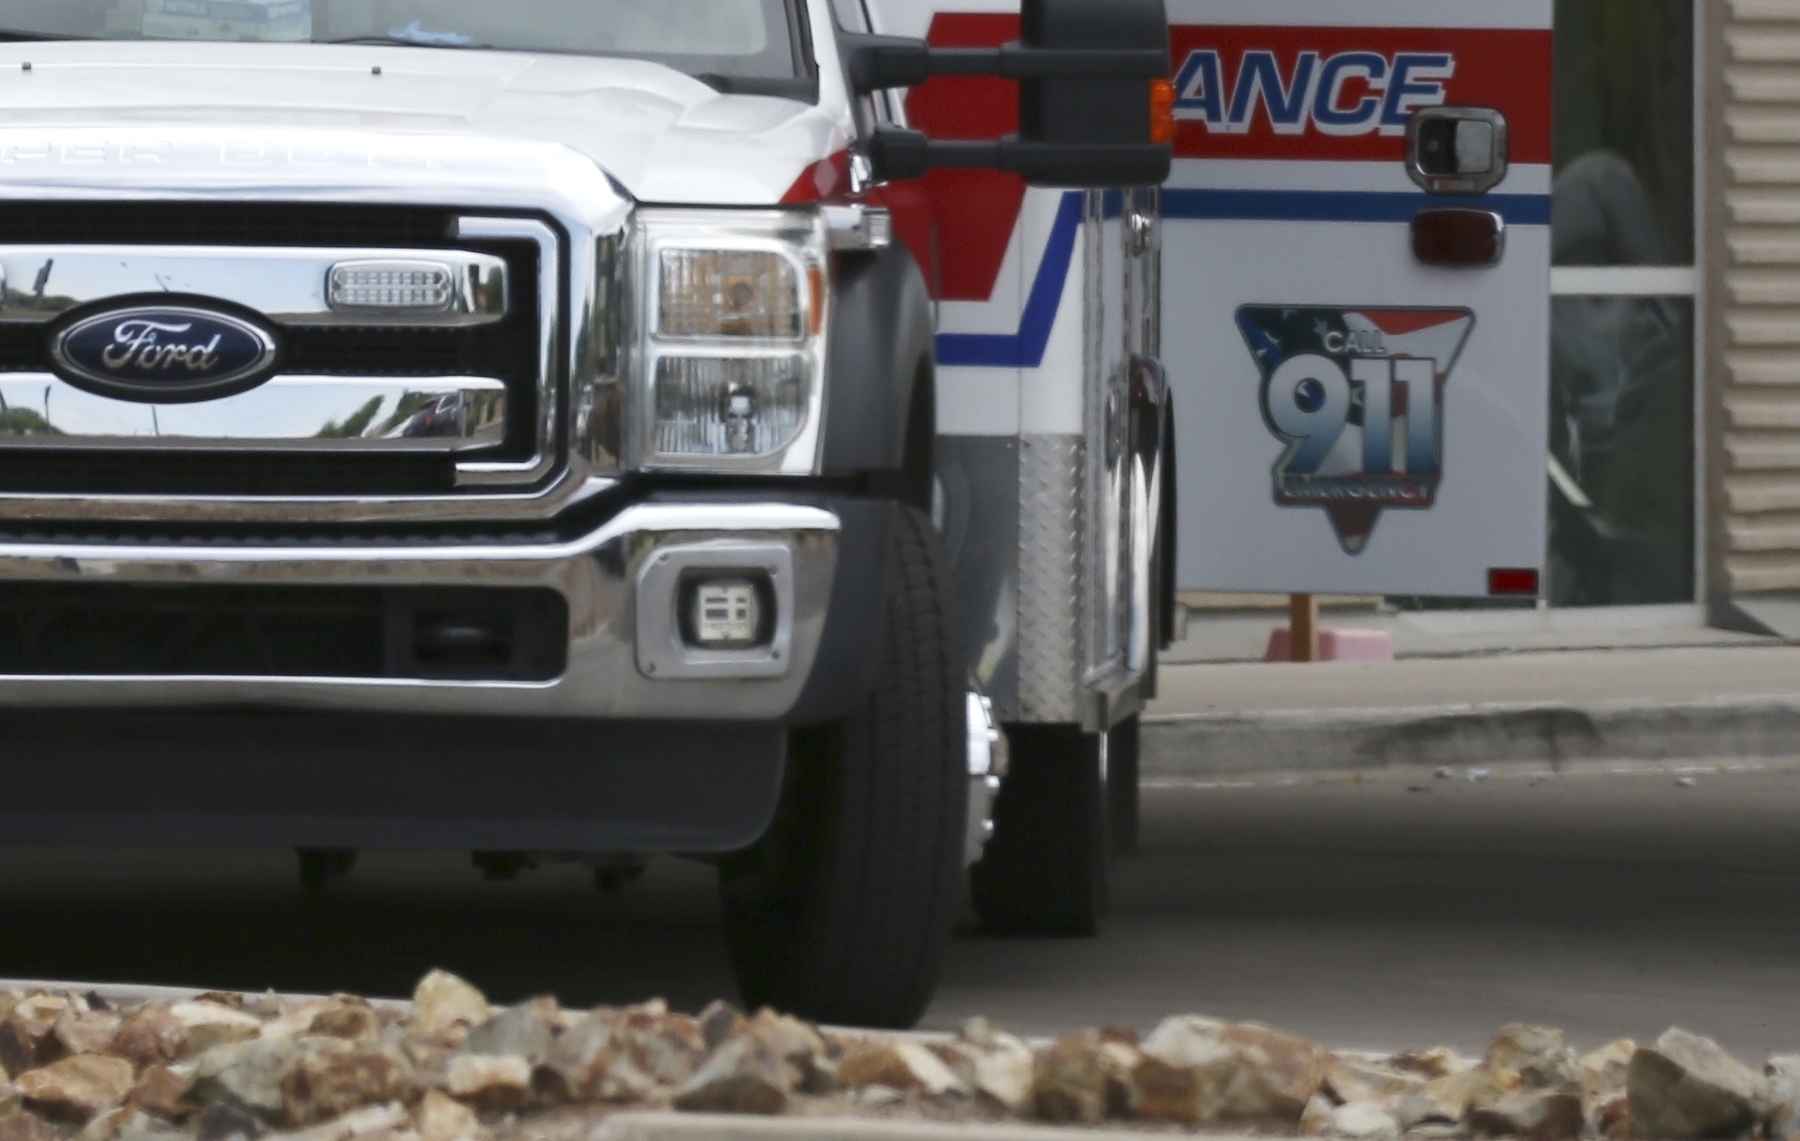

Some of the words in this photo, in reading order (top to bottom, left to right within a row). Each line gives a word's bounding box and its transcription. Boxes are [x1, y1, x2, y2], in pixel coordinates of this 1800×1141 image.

[103, 319, 219, 370] Ford
[1325, 330, 1386, 353] CALL
[1268, 353, 1436, 474] 911
